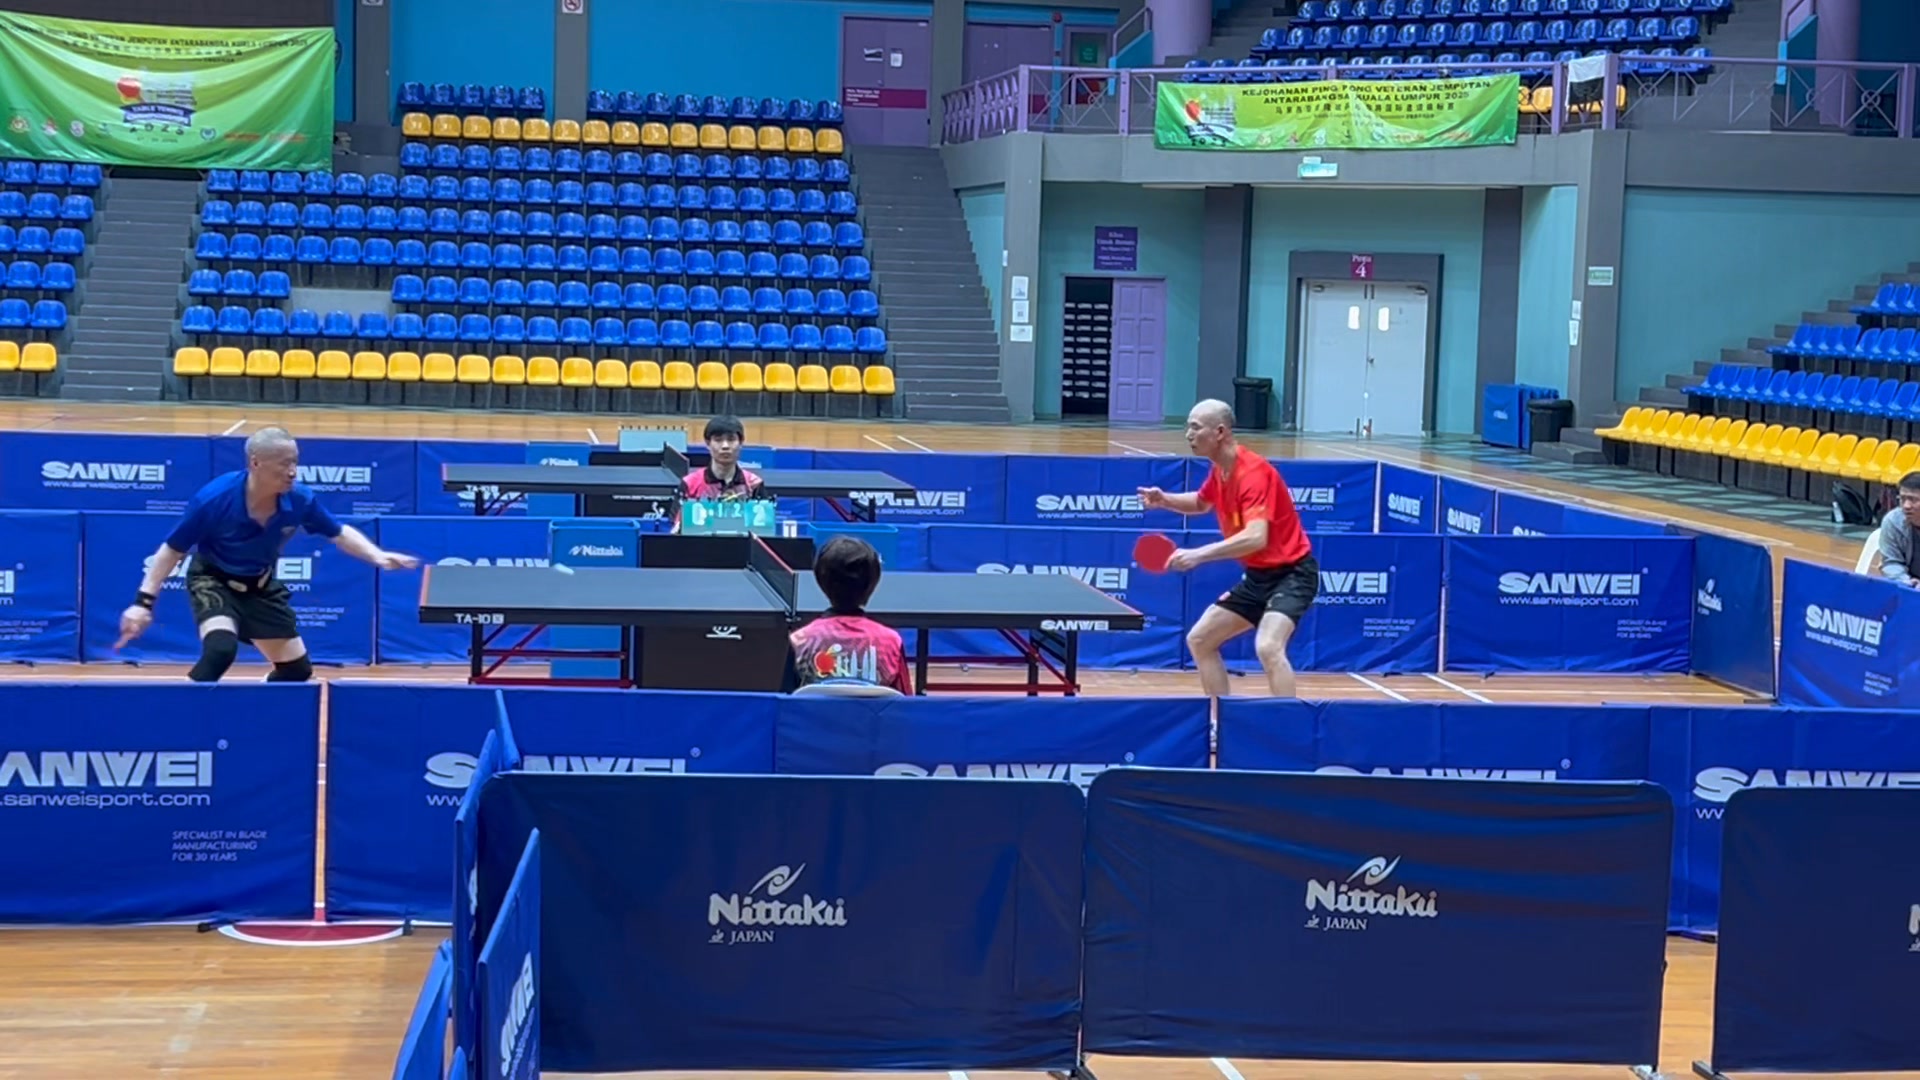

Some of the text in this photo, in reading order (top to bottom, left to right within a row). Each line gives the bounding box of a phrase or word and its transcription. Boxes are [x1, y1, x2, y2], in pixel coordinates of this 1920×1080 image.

[1242, 81, 1490, 96] KEJOHANAN PING PONG VETERAN JEMPUTAN
[1264, 93, 1350, 104] ANTARABANGSA
[1395, 92, 1440, 101] LUMPUR
[1355, 262, 1367, 278] 4
[41, 461, 165, 481] SANWEI
[295, 466, 371, 483] NWEI
[1287, 487, 1334, 503] WEI
[1318, 571, 1388, 594] WEI
[1498, 572, 1641, 595] SANWEI
[1499, 595, 1640, 607] www.sanweisport.com
[1040, 620, 1109, 632] SANWEI
[1805, 604, 1883, 646] SANWEI
[0, 751, 213, 787] ANWEI
[0, 790, 211, 809] .sanweisport.com
[172, 830, 224, 840] SPECIALIST
[171, 840, 258, 850] MANUFACTURING
[171, 852, 193, 862] FOR
[1305, 878, 1438, 918] Nittaku
[708, 892, 848, 926] Nittaku
[1323, 916, 1368, 931] JAPAN
[728, 930, 775, 945] JAPAN
